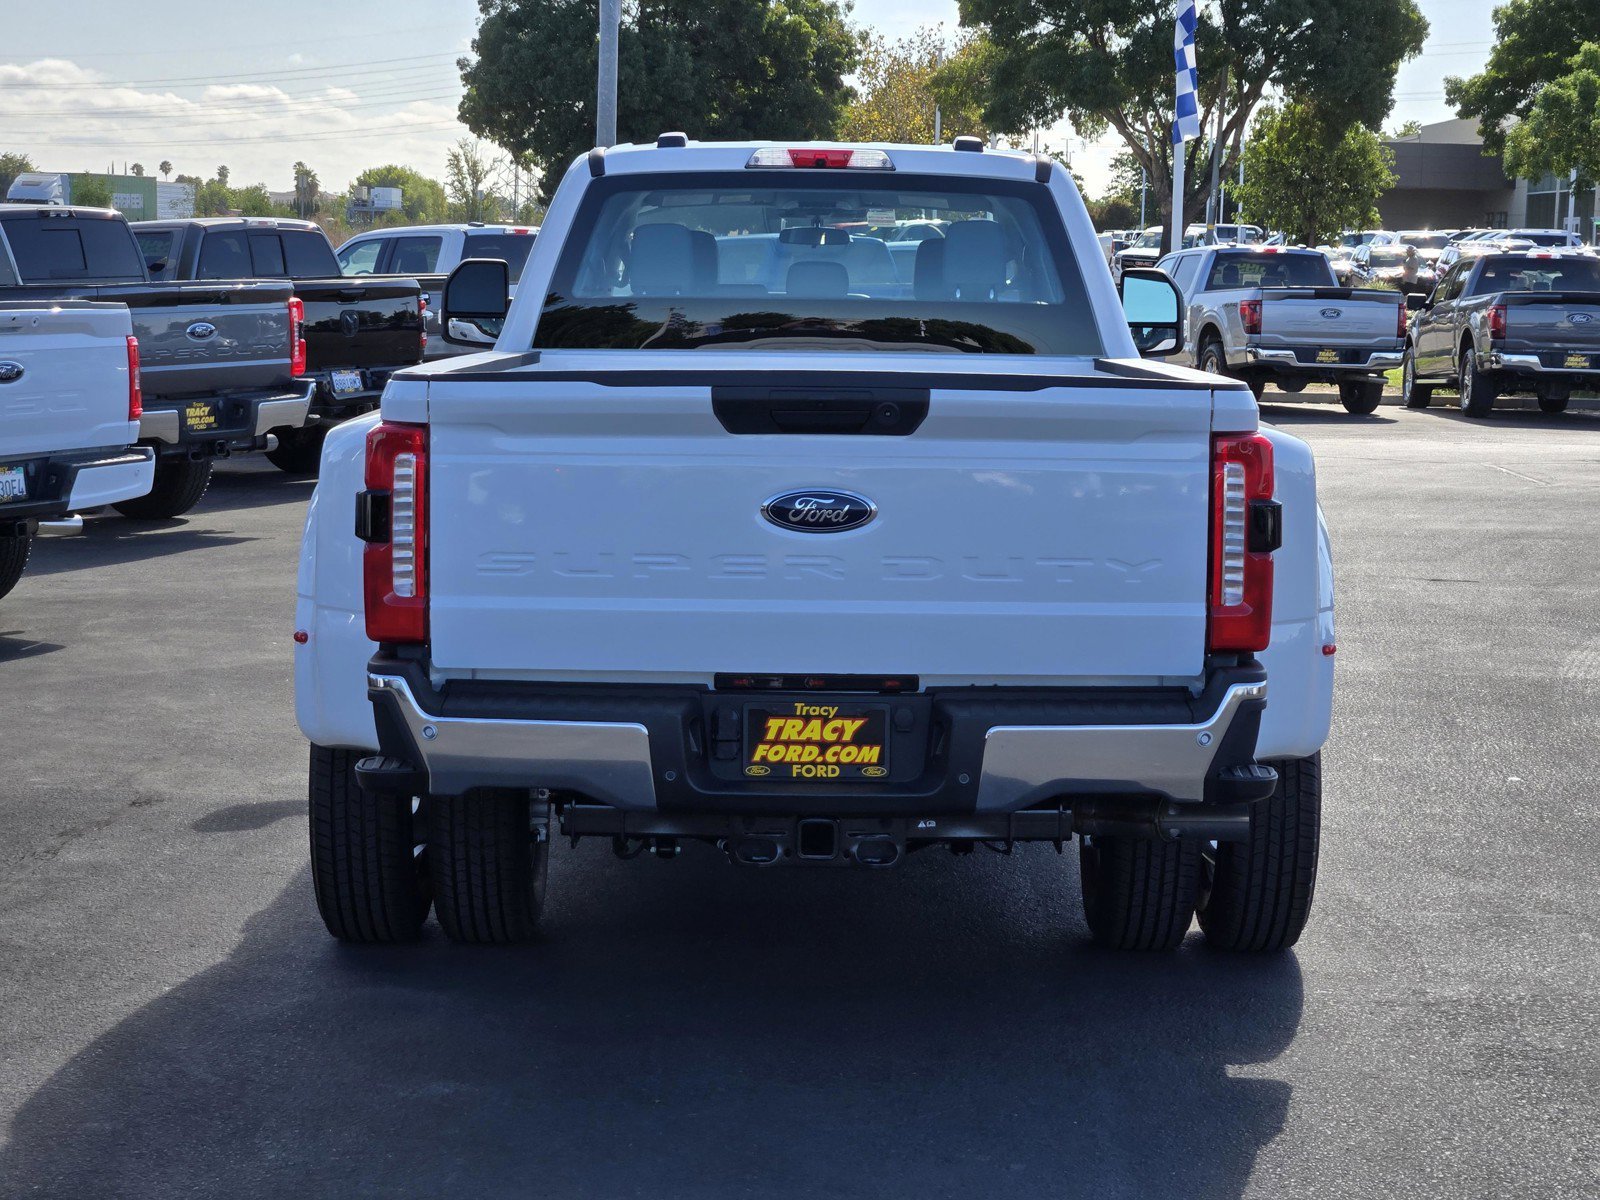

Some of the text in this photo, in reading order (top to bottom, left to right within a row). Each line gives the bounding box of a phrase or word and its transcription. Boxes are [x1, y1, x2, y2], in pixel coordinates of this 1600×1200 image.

[217, 344, 283, 357] DUTY
[186, 406, 211, 417] TRACY
[788, 497, 850, 523] Ford
[475, 551, 1164, 583] SUPER DUTY
[794, 702, 839, 719] Tracy
[764, 717, 868, 742] TRACY
[751, 744, 882, 763] FORD.COM
[792, 764, 840, 778] FORD
